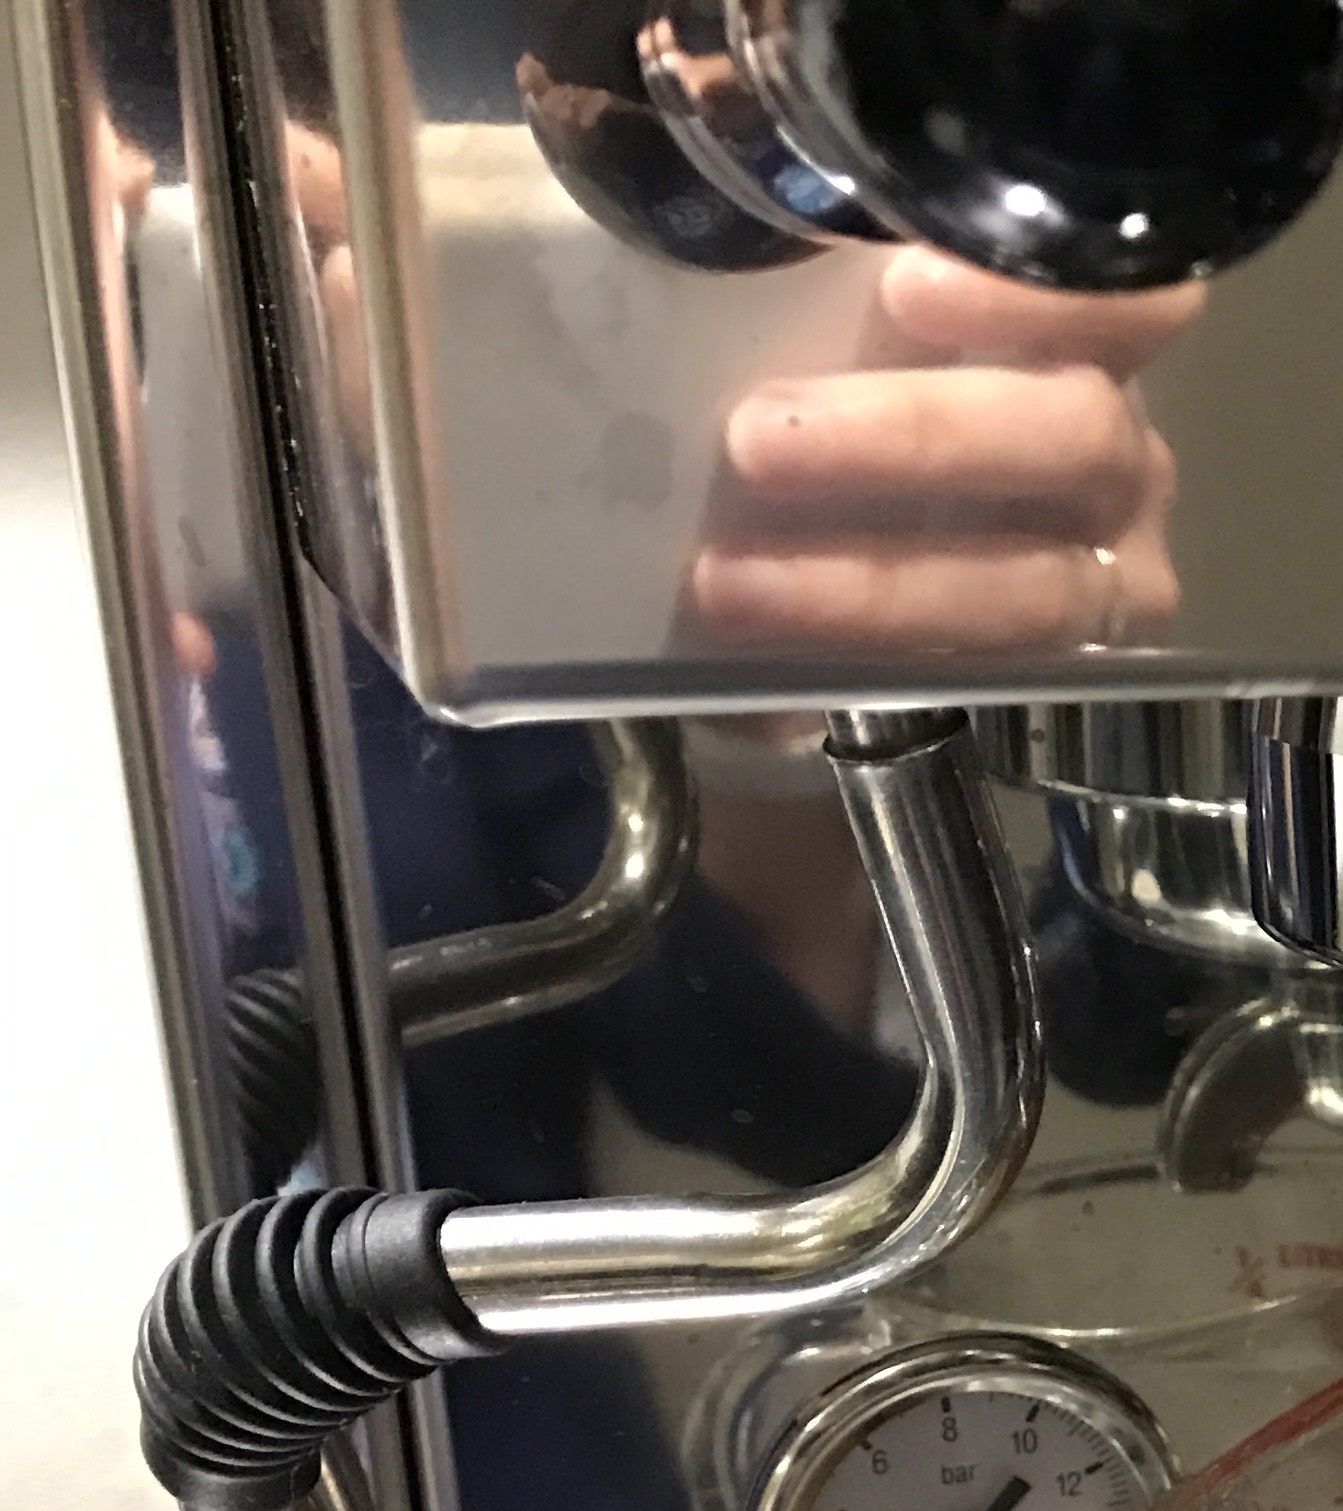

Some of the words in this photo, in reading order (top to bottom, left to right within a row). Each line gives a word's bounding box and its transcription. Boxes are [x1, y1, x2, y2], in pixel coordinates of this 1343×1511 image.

[942, 1416, 958, 1442] 8
[1012, 1428, 1039, 1455] 10
[872, 1450, 889, 1475] 6
[941, 1463, 978, 1485] bar
[1057, 1471, 1083, 1498] 12
